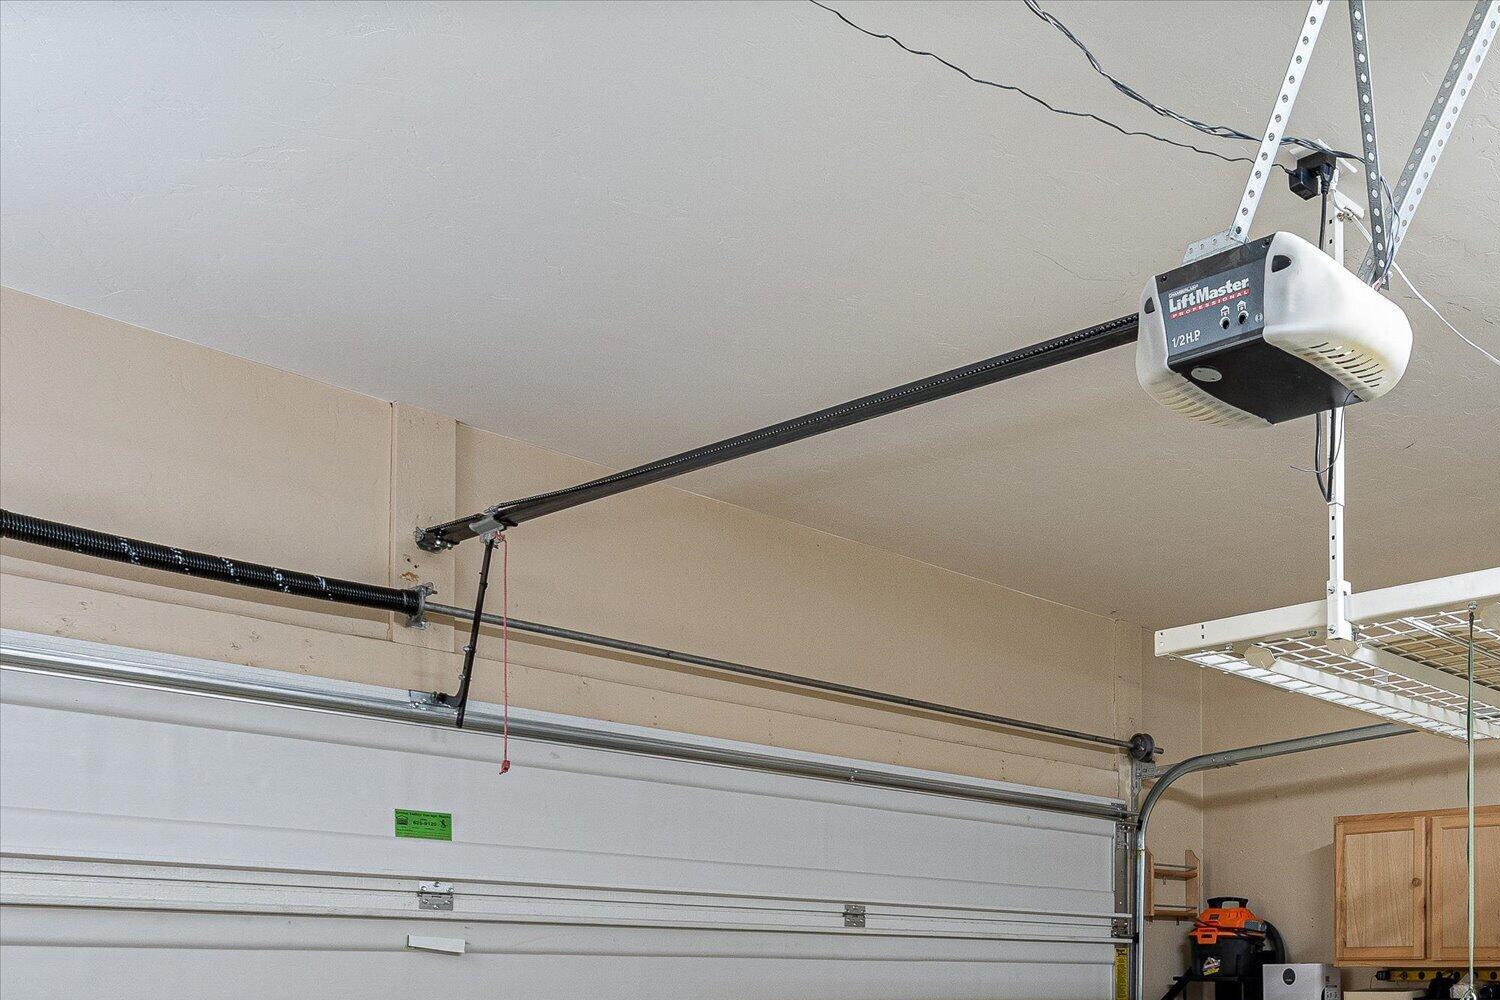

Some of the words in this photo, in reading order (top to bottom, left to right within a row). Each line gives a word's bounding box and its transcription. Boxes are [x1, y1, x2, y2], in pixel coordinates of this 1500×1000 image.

[1169, 277, 1250, 313] LiftMaster
[1172, 290, 1250, 319] PROFESSIONAL
[1171, 334, 1186, 348] 1/2
